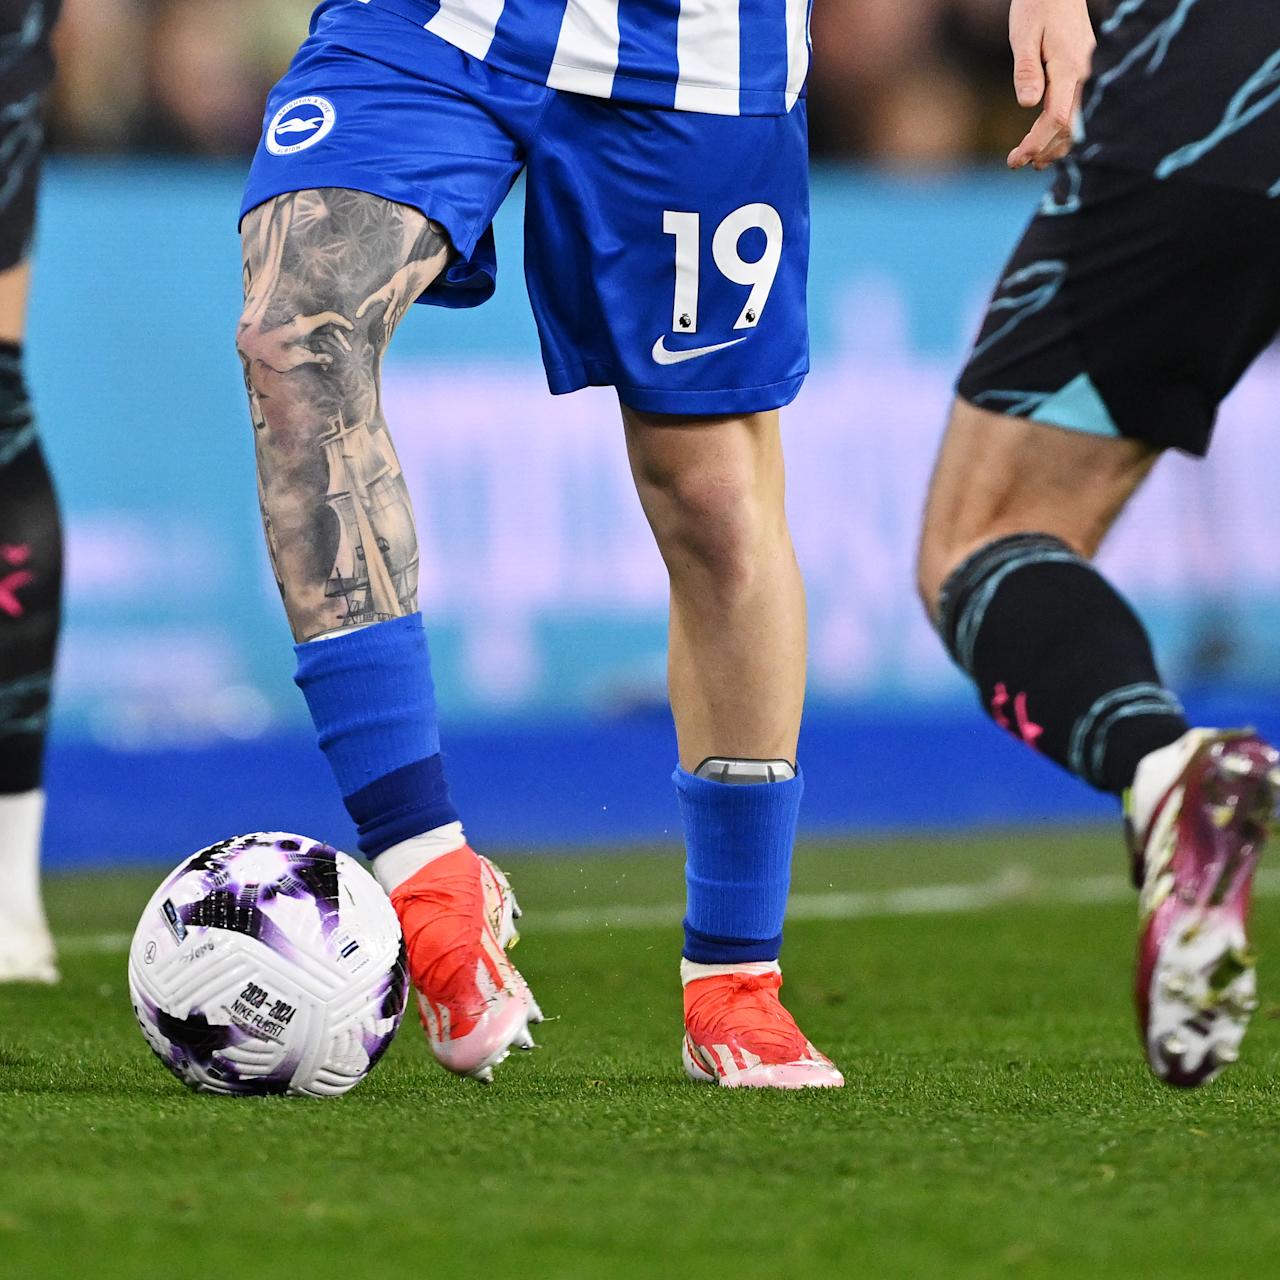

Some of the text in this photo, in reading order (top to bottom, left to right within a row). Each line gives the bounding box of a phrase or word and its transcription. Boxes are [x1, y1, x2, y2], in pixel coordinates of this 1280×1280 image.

[663, 203, 783, 333] 19
[231, 999, 255, 1021] NIKE
[251, 1014, 286, 1038] FLIGHT
